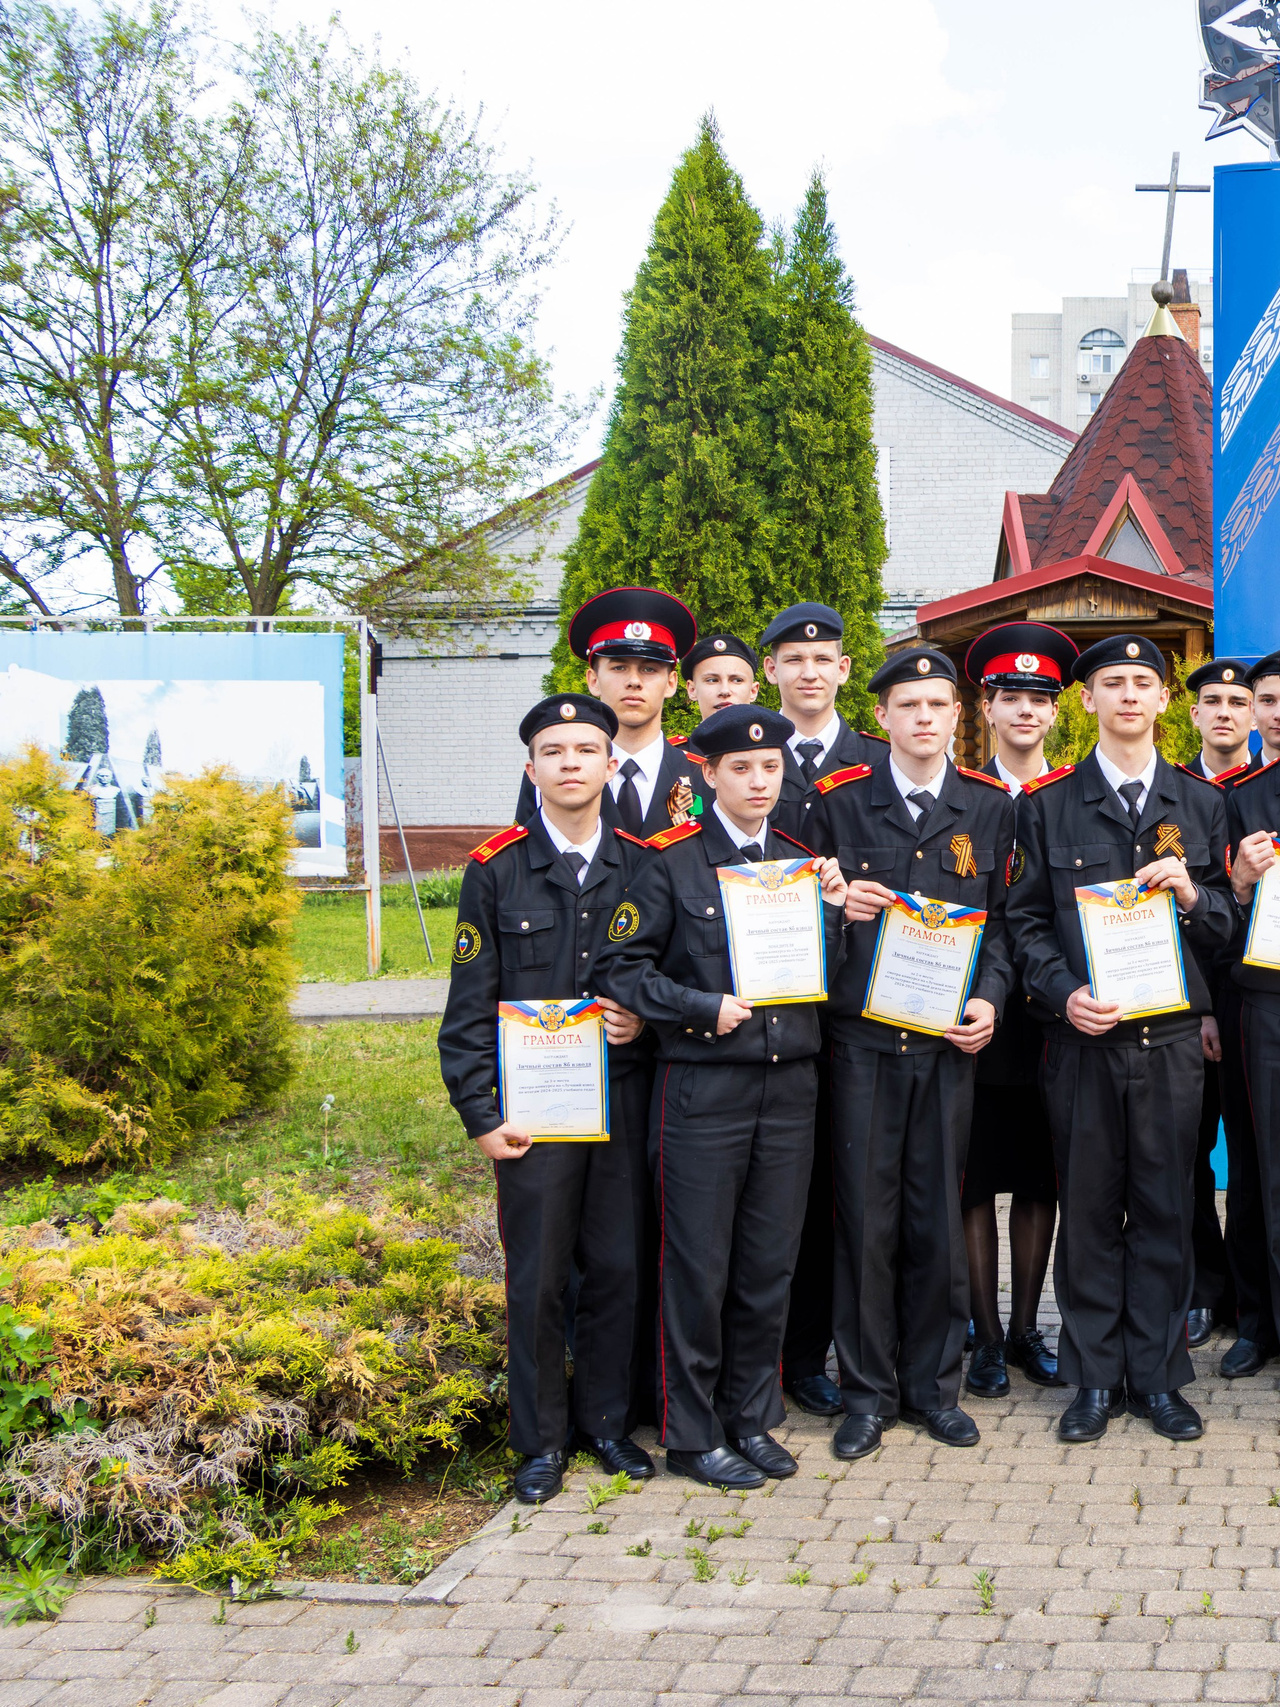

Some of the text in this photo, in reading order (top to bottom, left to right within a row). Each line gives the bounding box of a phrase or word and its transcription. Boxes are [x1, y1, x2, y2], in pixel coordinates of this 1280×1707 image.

[746, 893, 800, 904] ГРАМОТА
[1103, 909, 1154, 925] ГРАМОТА
[902, 926, 956, 945] ГРАМОТА
[523, 1034, 582, 1045] ГРАМОТА
